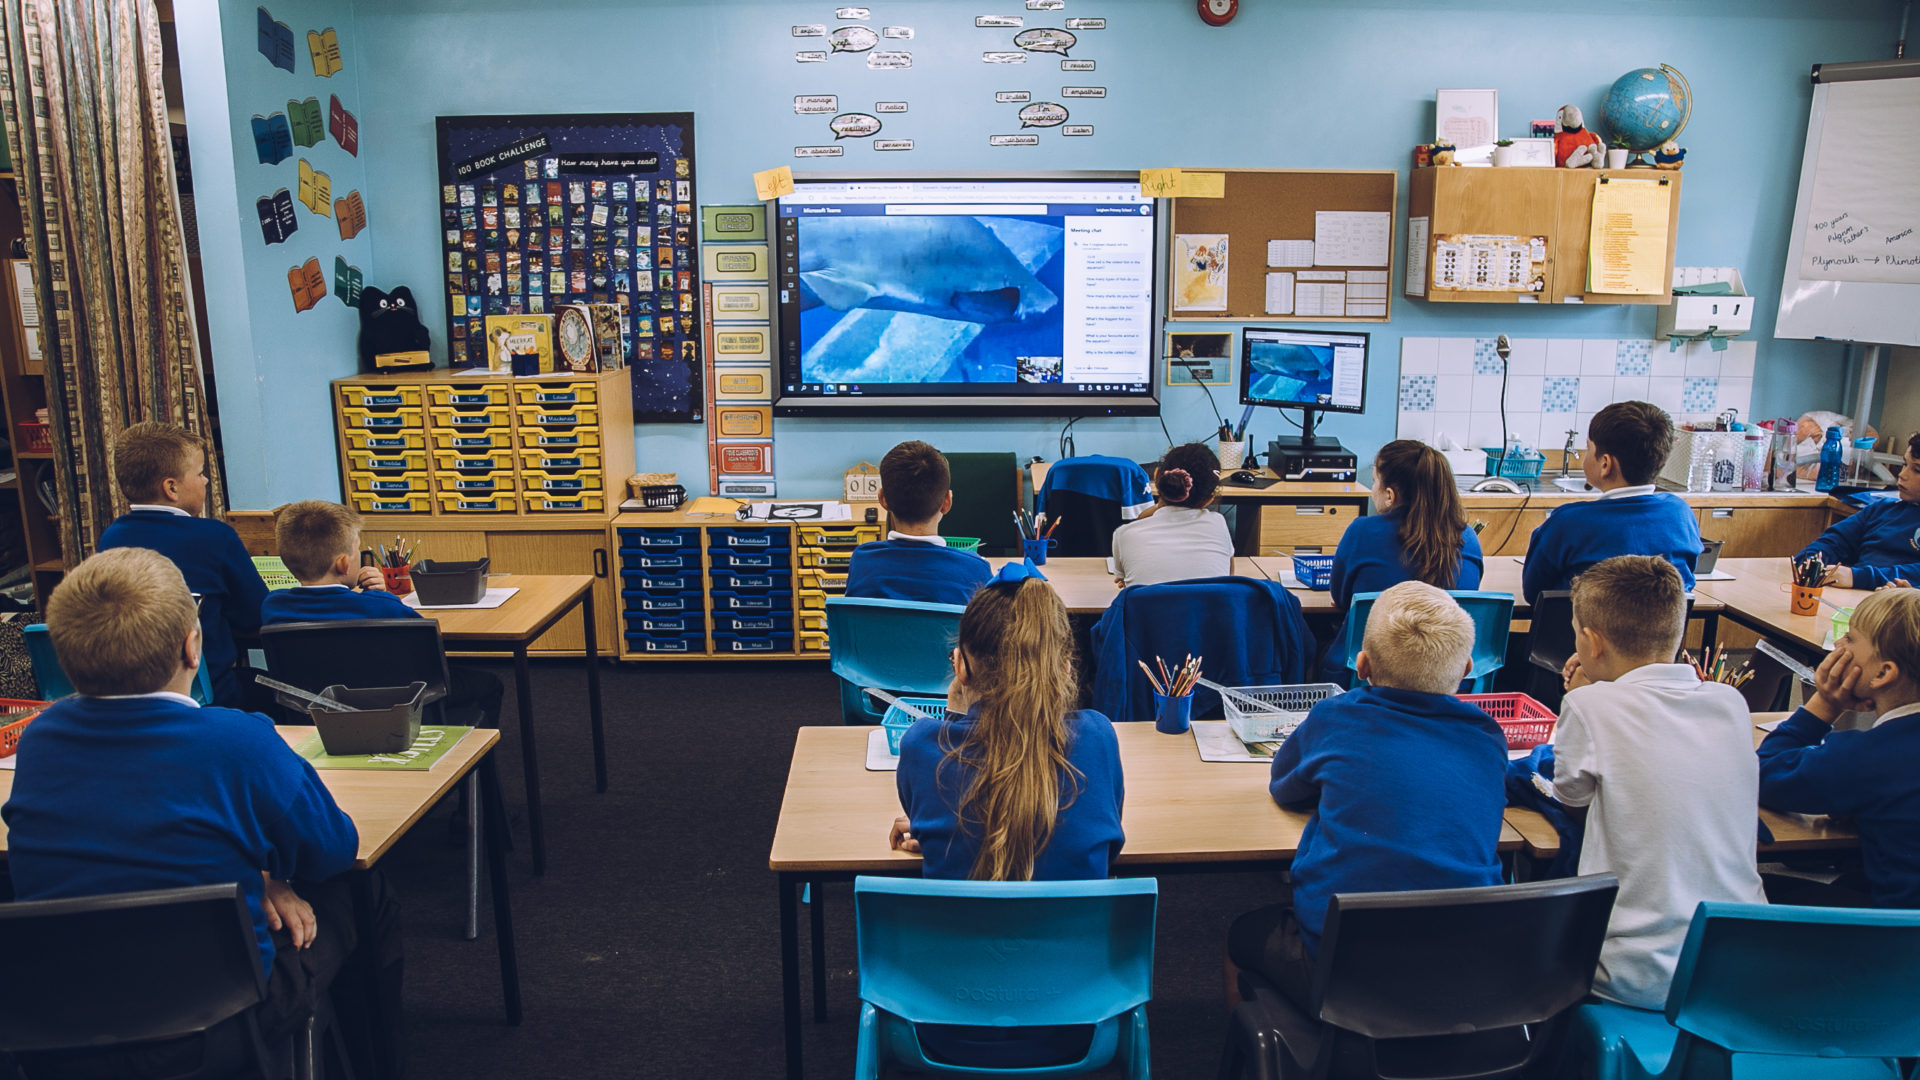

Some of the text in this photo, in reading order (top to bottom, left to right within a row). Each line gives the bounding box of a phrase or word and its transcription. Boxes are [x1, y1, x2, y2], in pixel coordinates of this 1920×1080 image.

[458, 137, 547, 175] 100 BOOK CHALLENGE
[579, 160, 599, 168] many
[601, 158, 619, 166] have
[620, 160, 636, 168] you
[1142, 172, 1176, 197] Right
[1812, 254, 1860, 272] Plymouth
[509, 336, 534, 344] MEERKAT
[868, 479, 878, 493] 8
